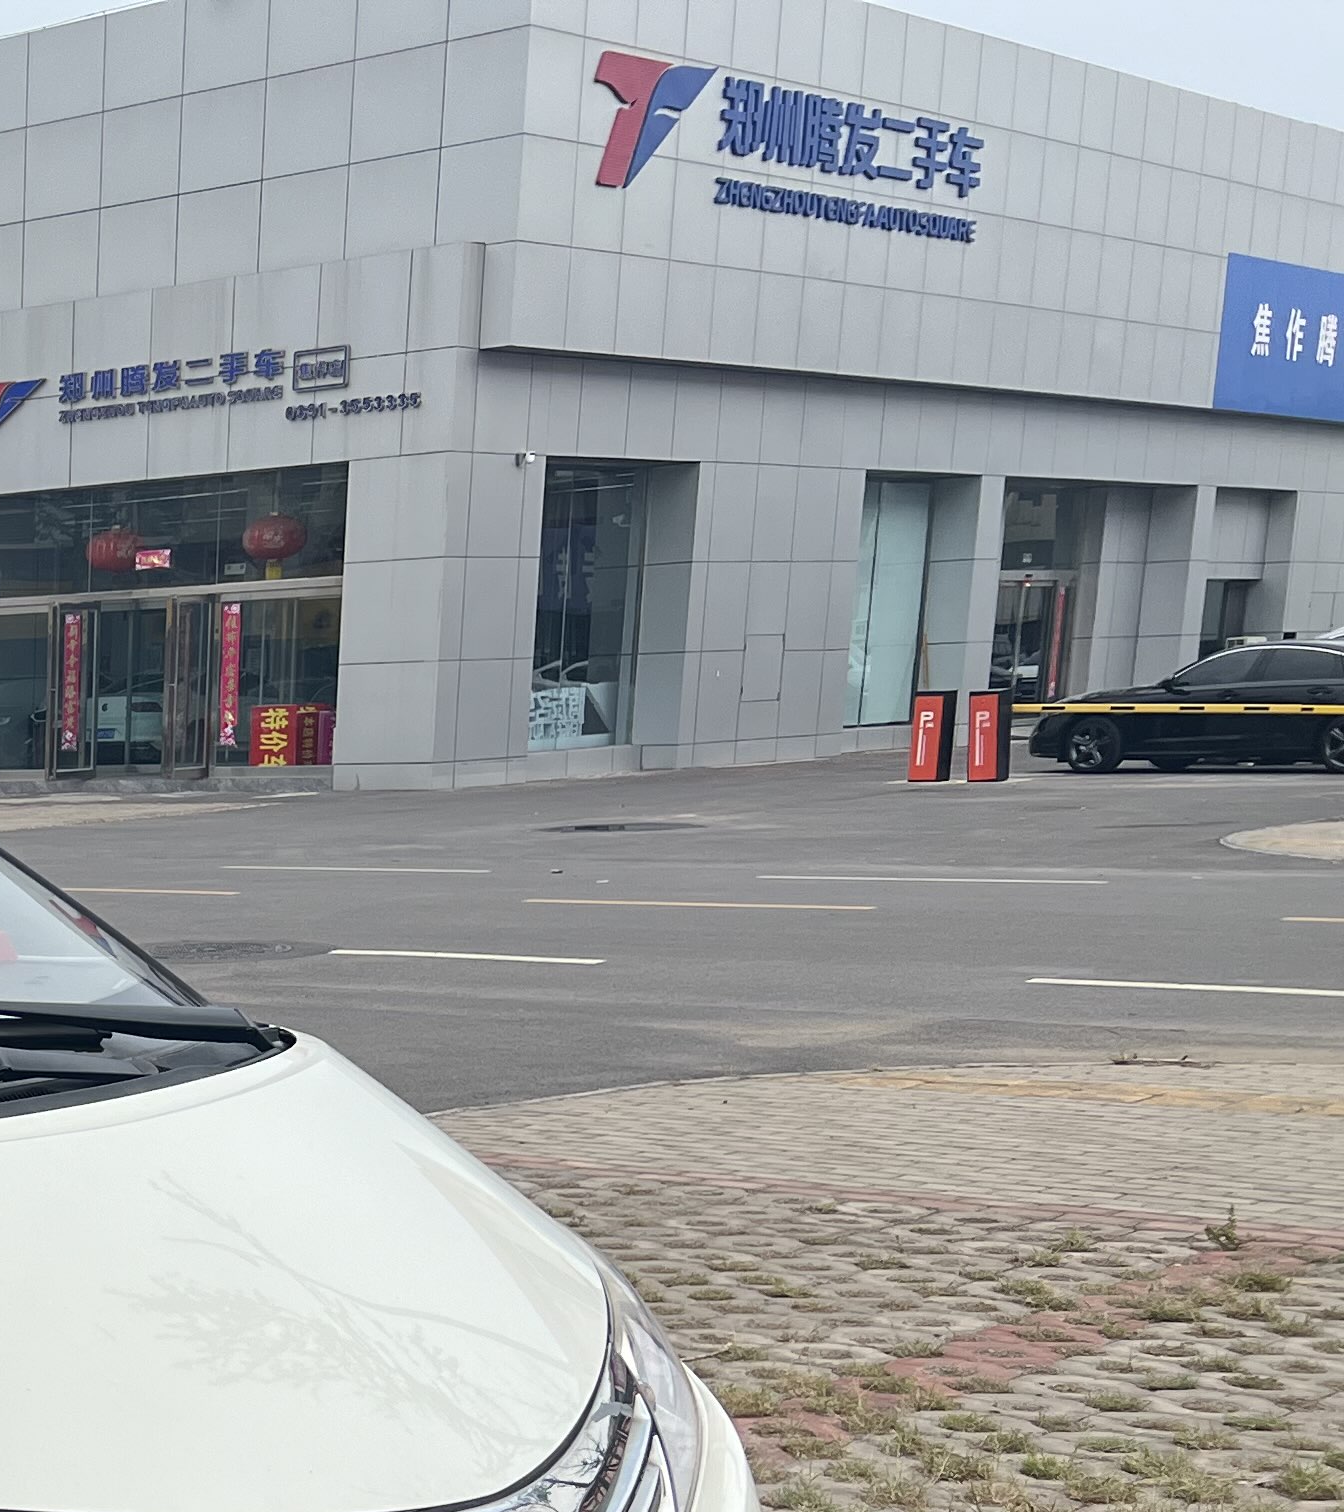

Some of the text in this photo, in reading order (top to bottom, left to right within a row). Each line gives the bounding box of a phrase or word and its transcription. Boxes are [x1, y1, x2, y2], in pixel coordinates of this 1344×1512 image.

[717, 76, 985, 199] 郑州腾发二手车
[58, 348, 286, 403] 郑州腾发二手车
